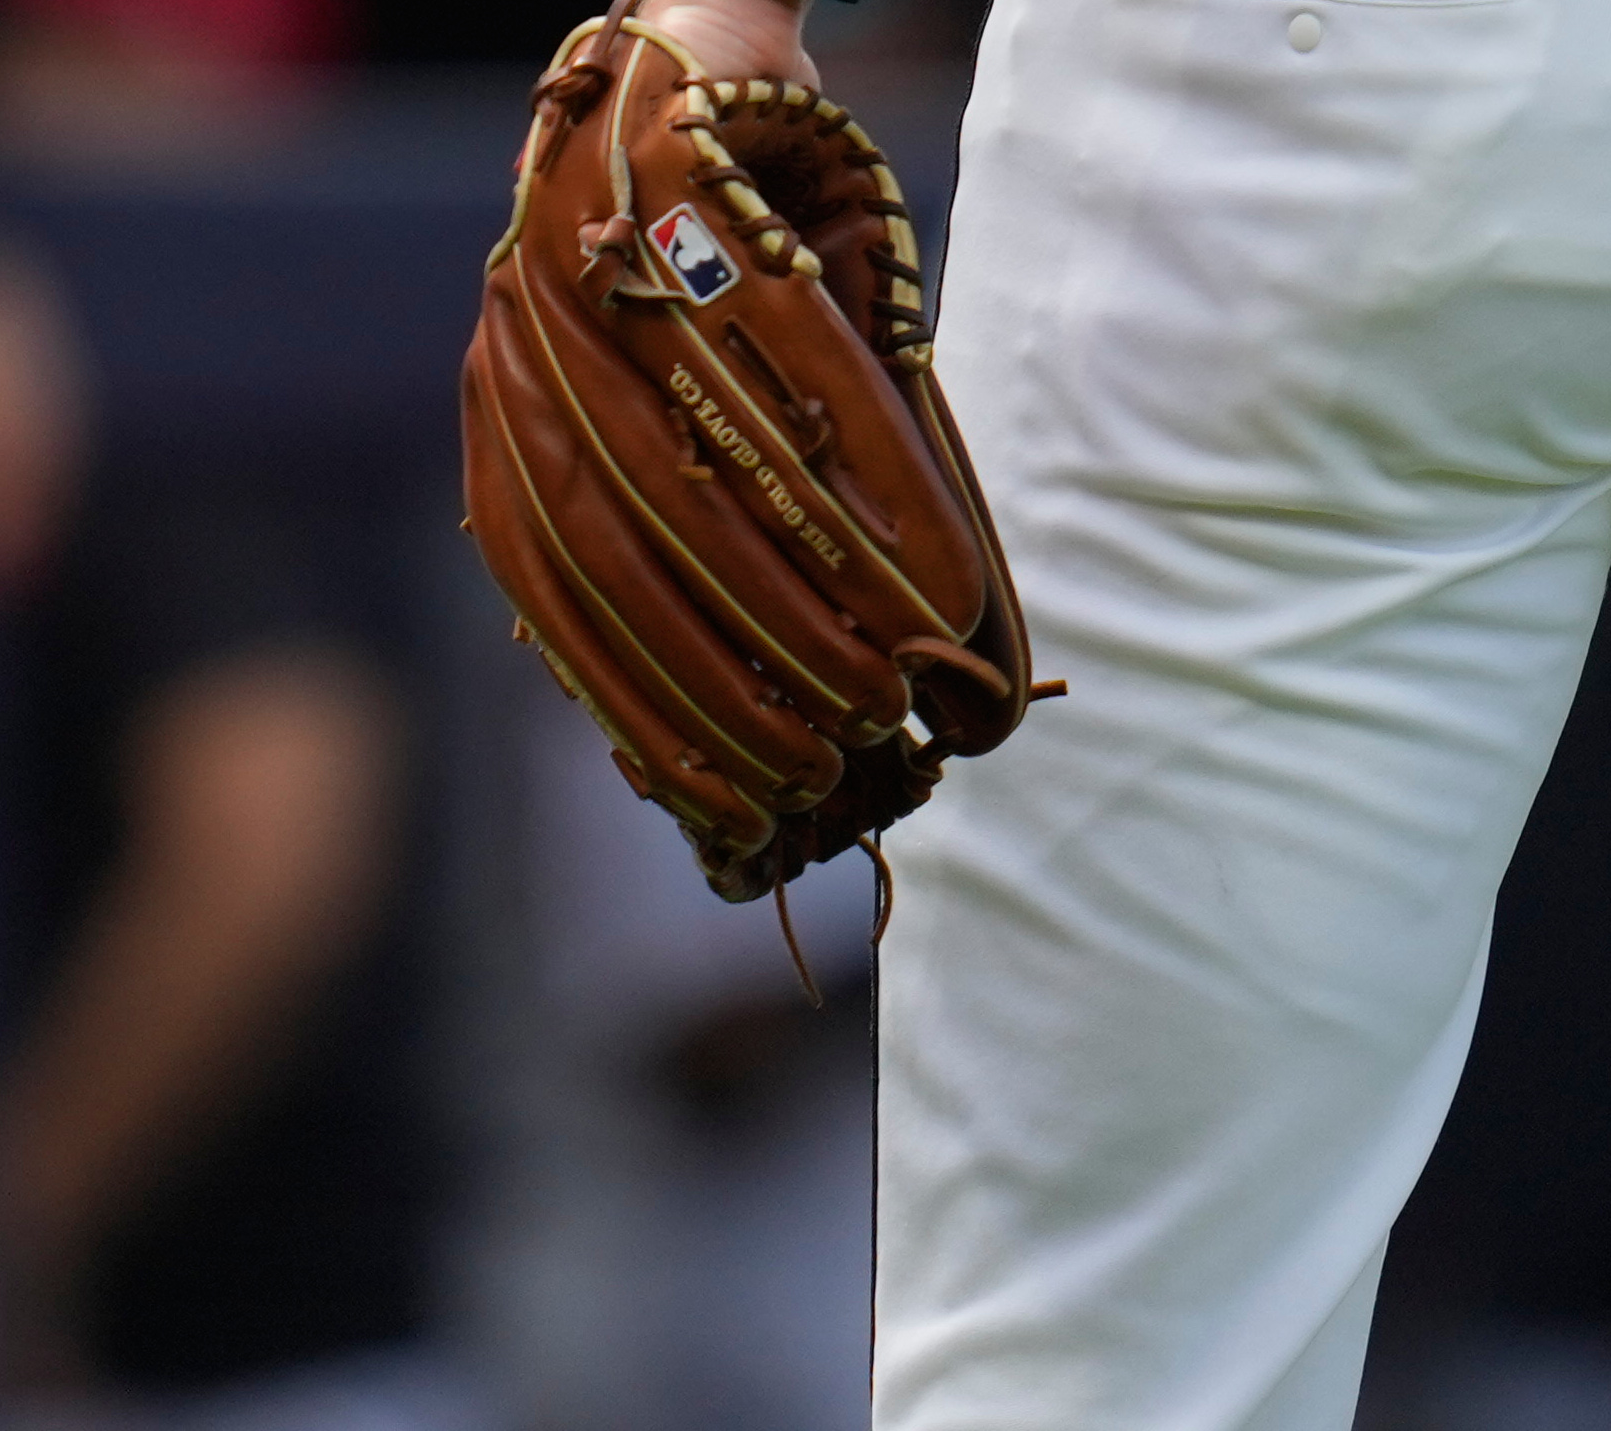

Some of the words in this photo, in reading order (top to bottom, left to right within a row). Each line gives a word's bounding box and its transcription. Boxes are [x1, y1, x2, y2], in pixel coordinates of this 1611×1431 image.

[669, 362, 703, 405] CO.
[693, 397, 762, 469] GLOVE
[755, 464, 806, 527] GOLD
